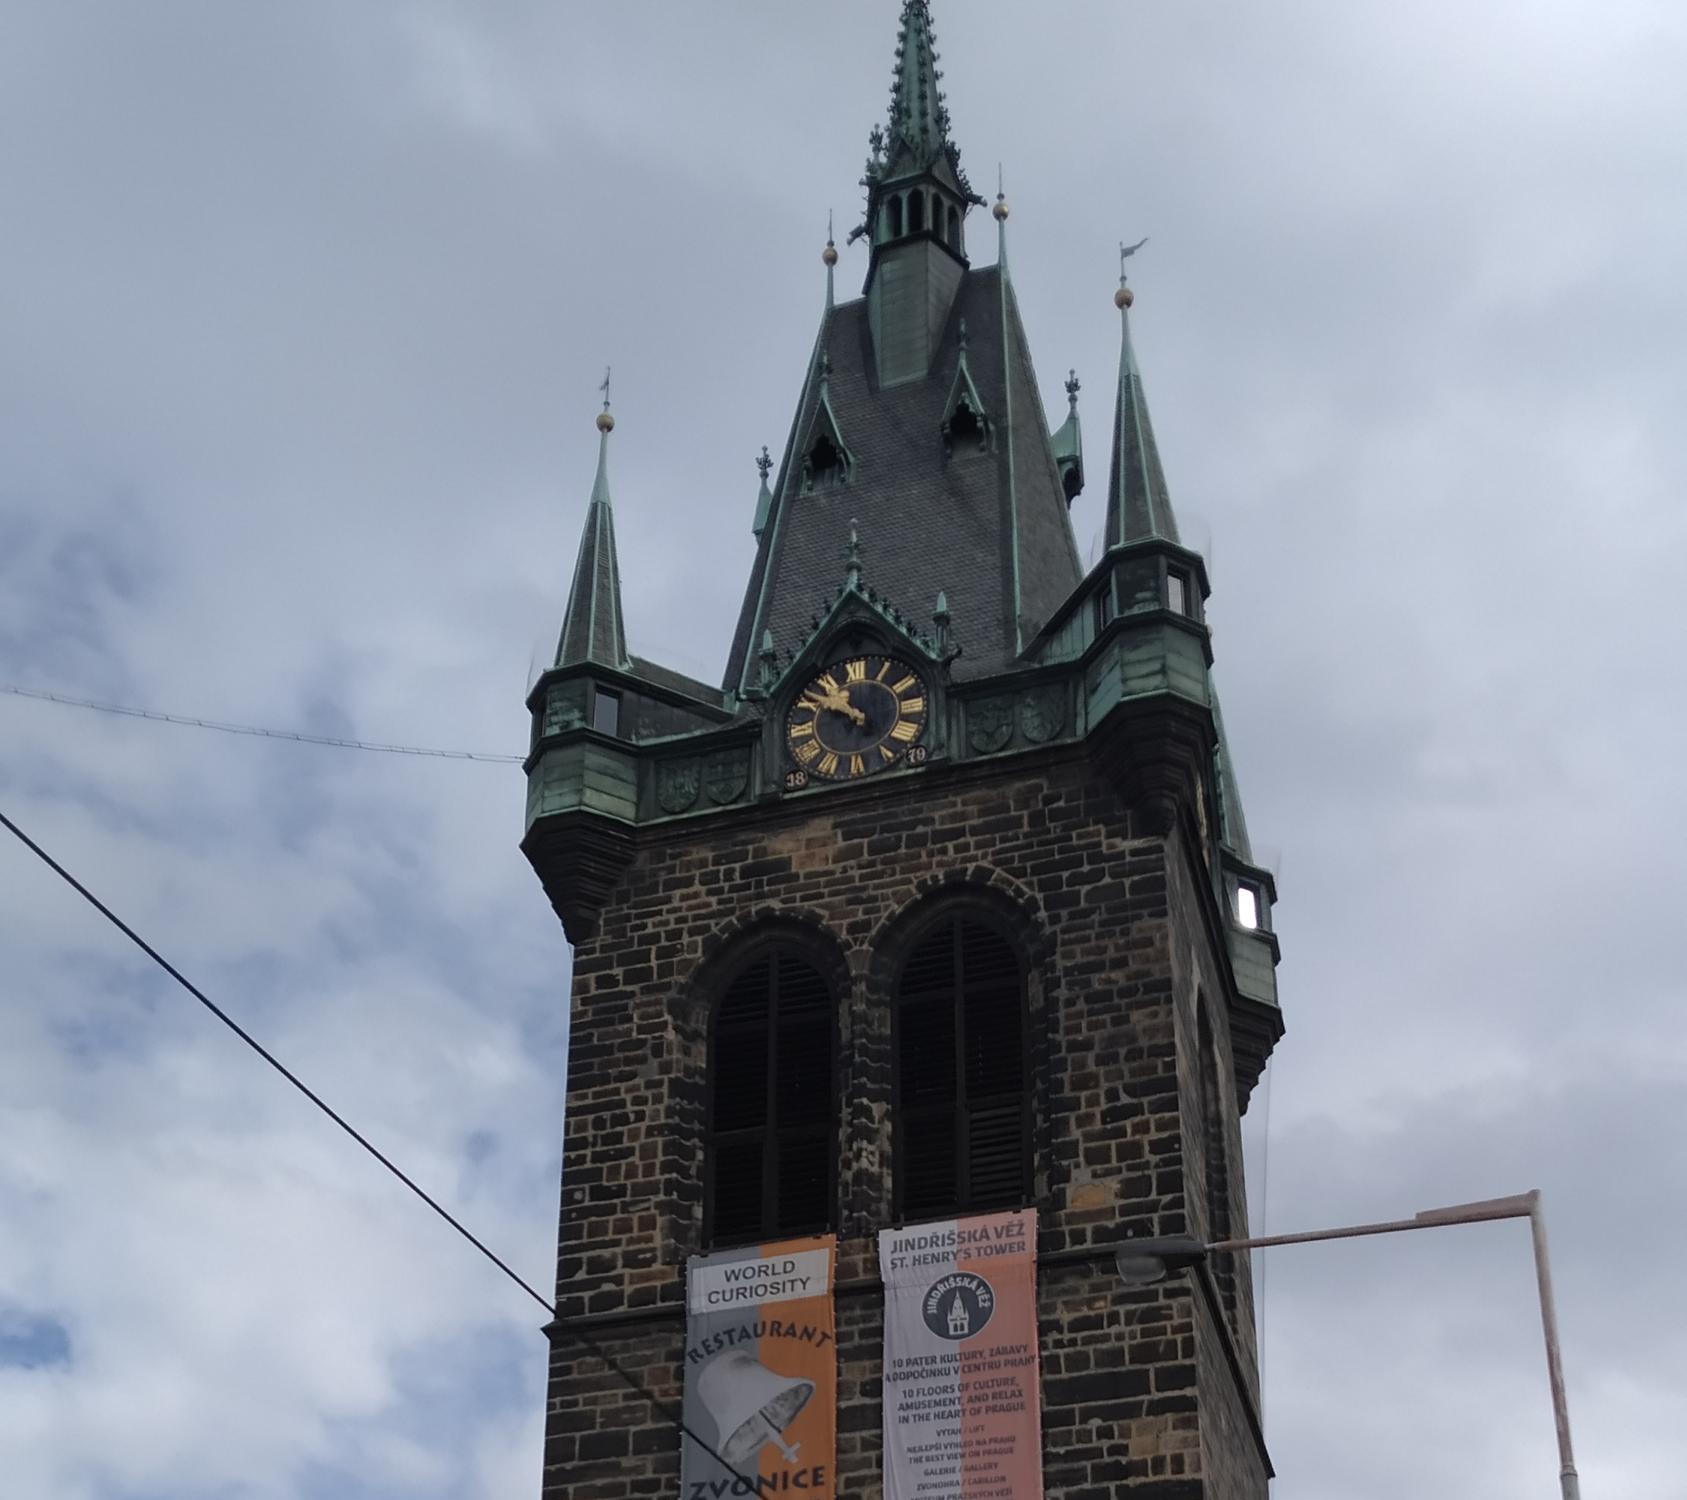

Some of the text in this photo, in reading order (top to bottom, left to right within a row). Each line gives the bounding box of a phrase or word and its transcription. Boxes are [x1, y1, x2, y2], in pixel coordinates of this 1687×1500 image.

[846, 660, 866, 682] XII
[908, 747, 926, 763] 79
[891, 1220, 1026, 1254] JINDŘIŠSKÁ VĚŽ
[890, 1241, 1026, 1270] ST. HENRY'S TOWER
[724, 1260, 795, 1282] WORLD
[708, 1276, 811, 1304] CURIOSITY
[687, 1320, 832, 1364] RESTAURANT
[892, 1359, 904, 1368] 10
[905, 1355, 937, 1367] PATER
[940, 1350, 987, 1364] KULTURY,
[953, 1366, 960, 1375] V
[961, 1359, 1001, 1374] CENTRU
[902, 1389, 914, 1399] 10
[916, 1384, 955, 1398] FLOORS
[957, 1382, 969, 1392] OF
[966, 1393, 990, 1405] AND
[992, 1389, 1024, 1401] RELAX
[898, 1401, 1026, 1424] IN THE HEART OF PRAGUE
[909, 1455, 923, 1464] THE
[925, 1453, 944, 1463] BEST
[946, 1450, 967, 1461] VIEW
[924, 1466, 957, 1477] GALERIE
[964, 1462, 998, 1473] GALLERY
